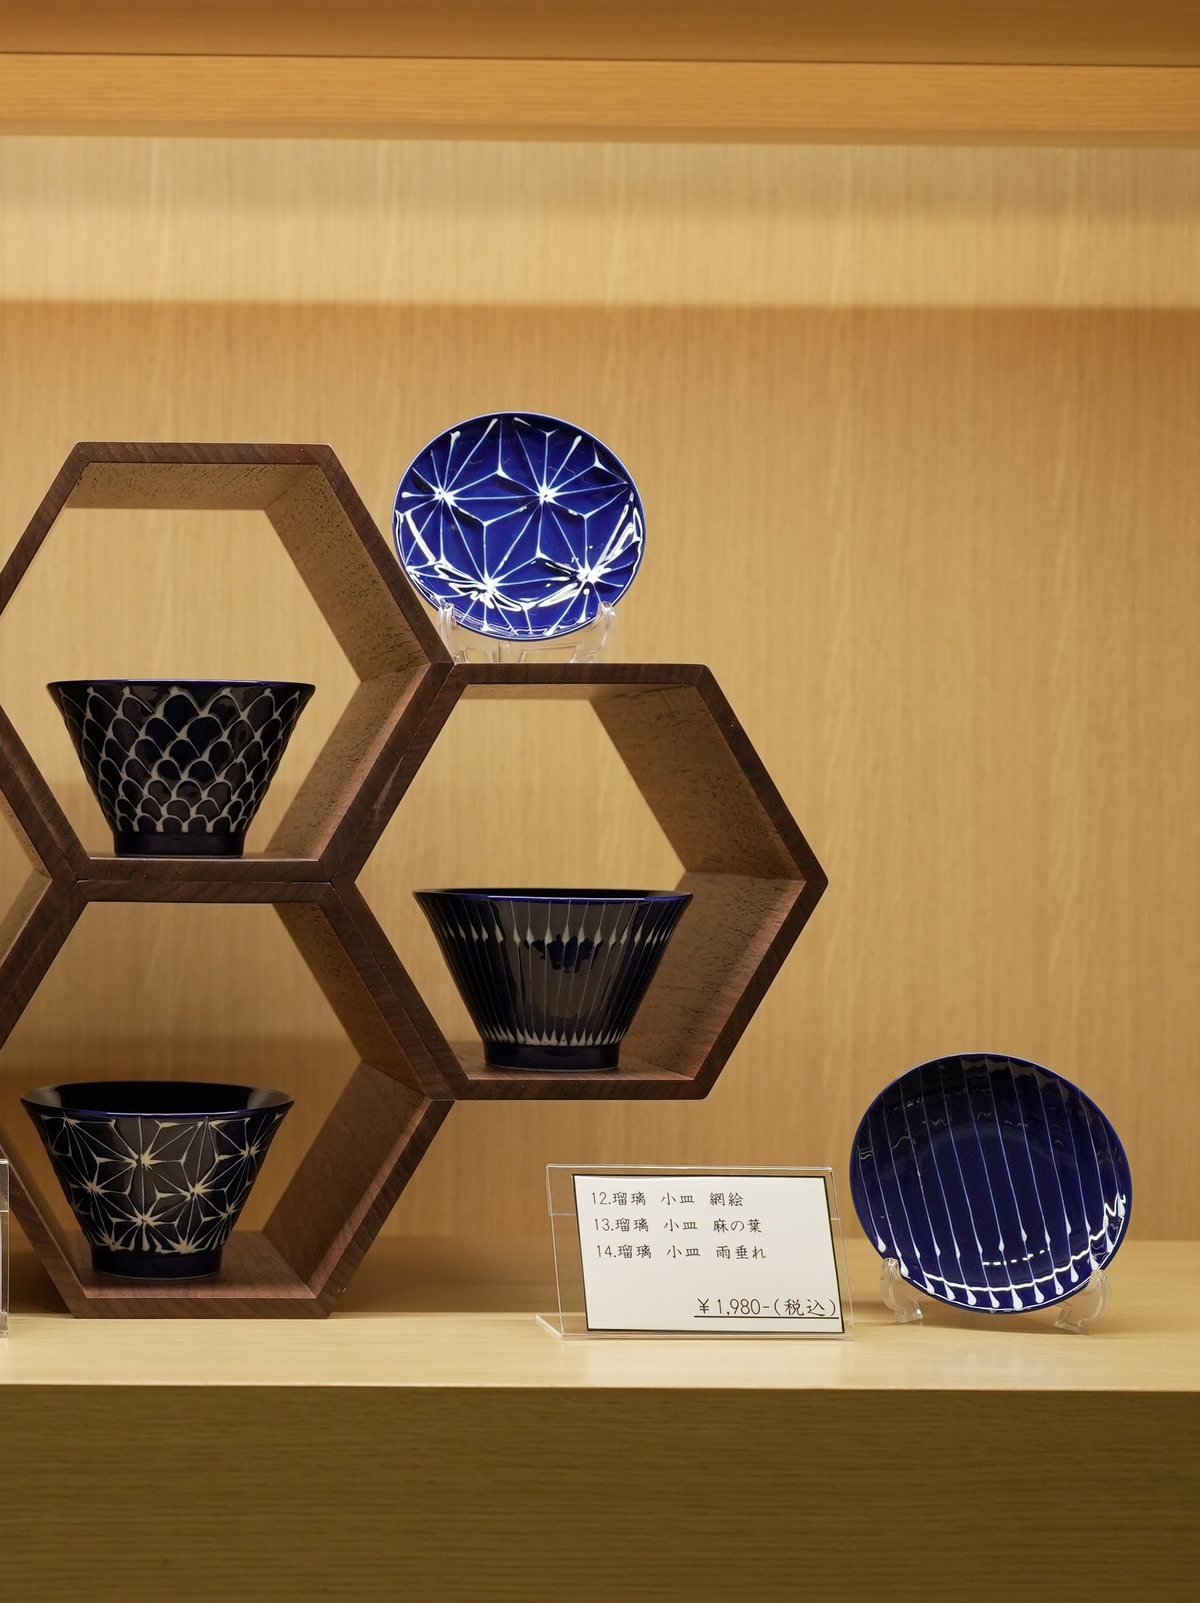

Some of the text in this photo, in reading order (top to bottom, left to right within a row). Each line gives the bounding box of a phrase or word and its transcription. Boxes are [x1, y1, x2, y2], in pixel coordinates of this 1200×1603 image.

[592, 1192, 744, 1207] 12.瑠璃 小皿 網絵
[595, 1218, 762, 1233] 13.瑠璃 小皿 麻の葉
[597, 1245, 766, 1259] 14.瑠璃 小皿 雨垂れ
